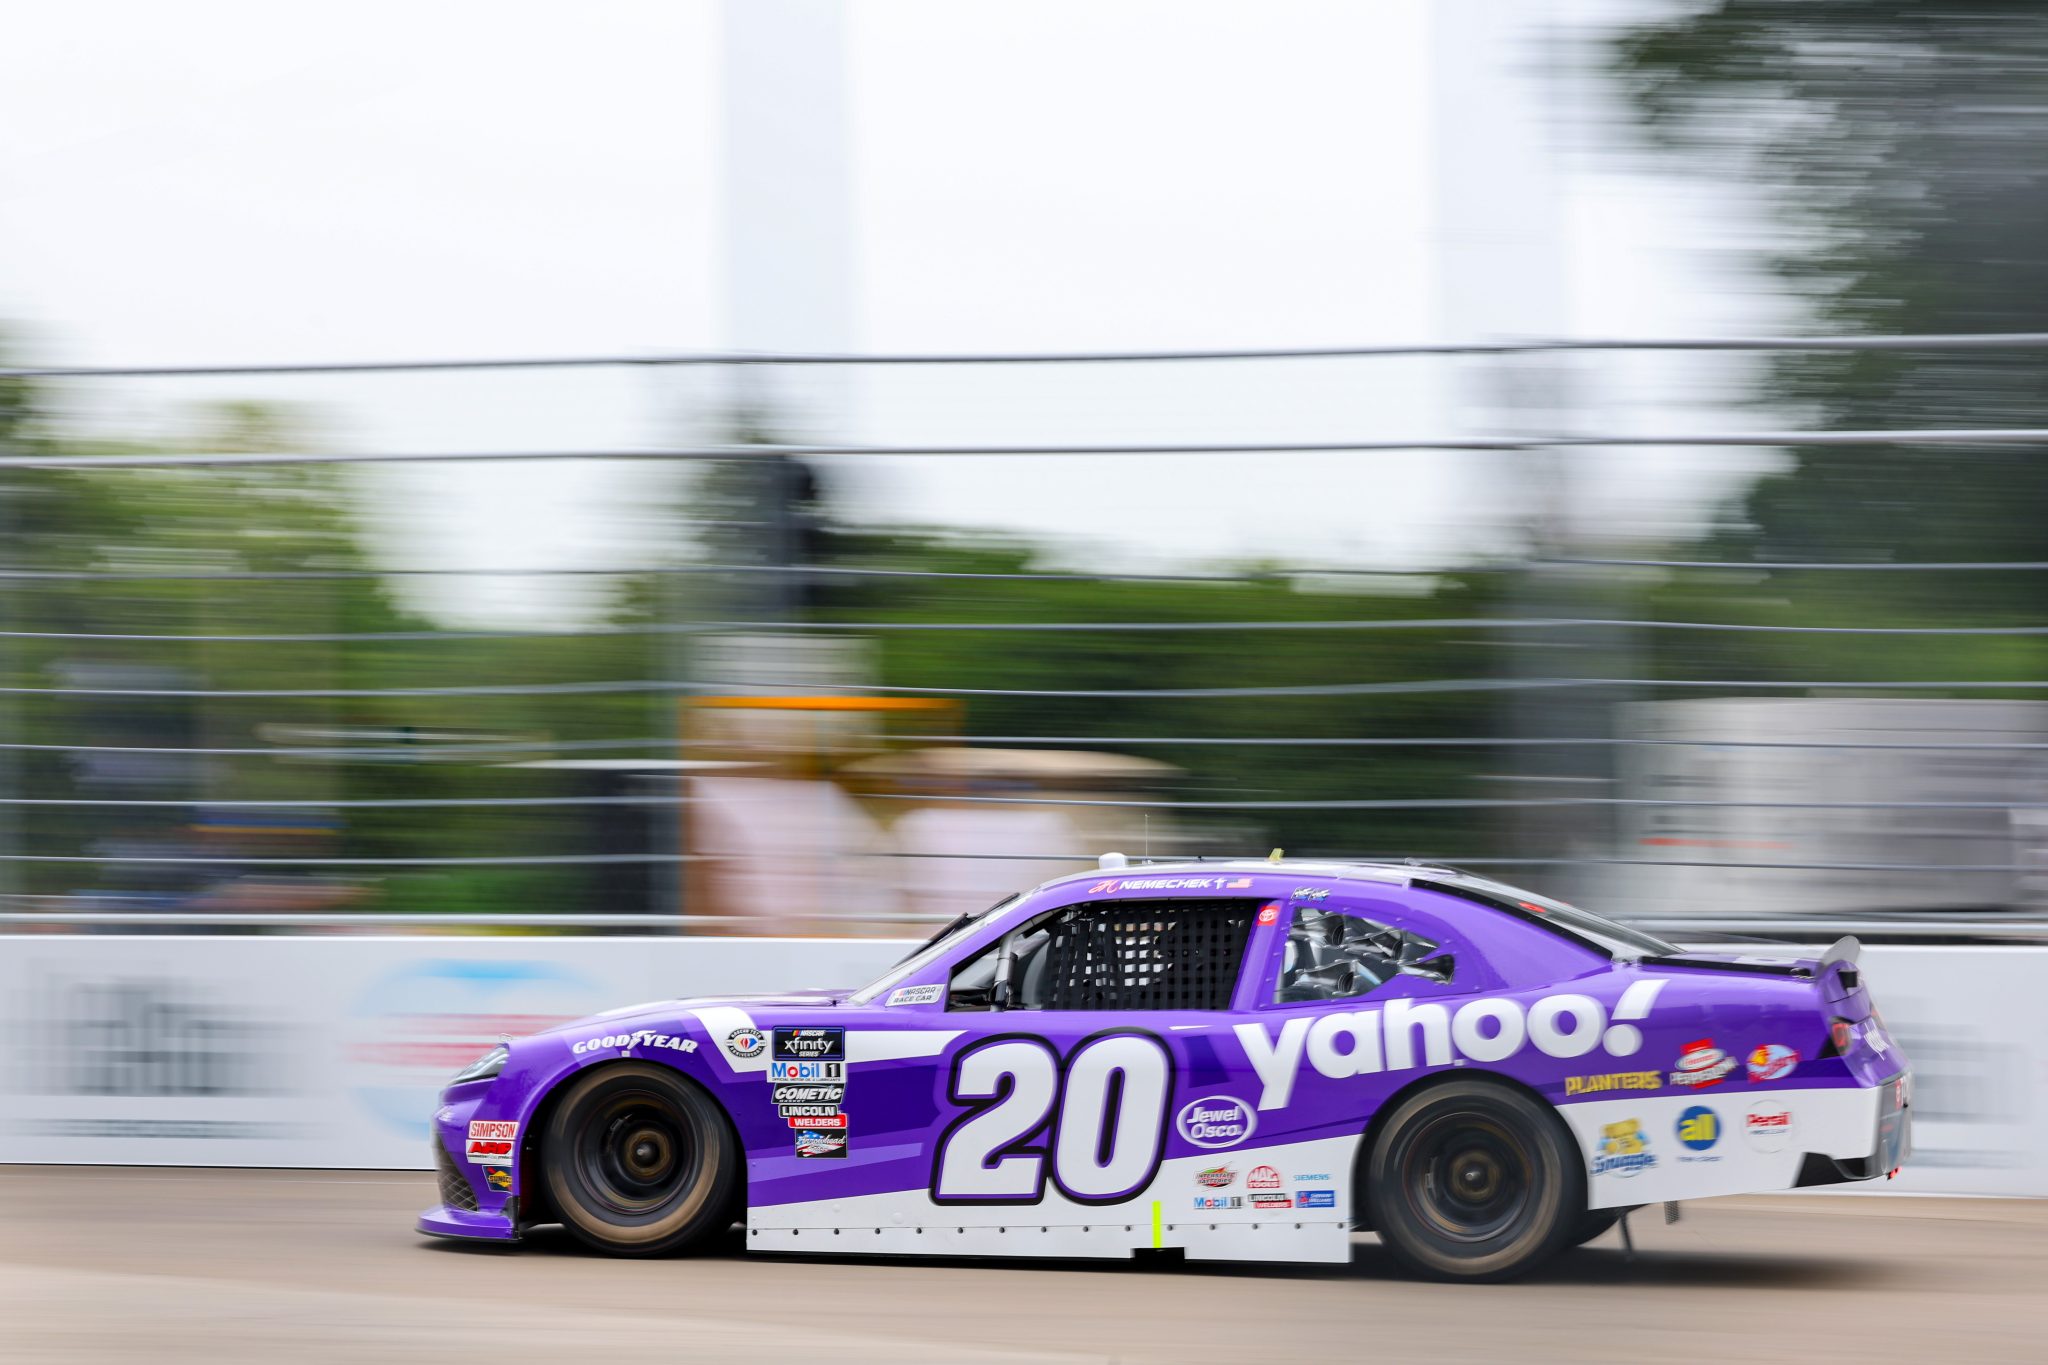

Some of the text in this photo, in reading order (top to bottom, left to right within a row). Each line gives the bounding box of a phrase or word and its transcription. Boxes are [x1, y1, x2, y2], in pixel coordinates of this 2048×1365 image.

[1119, 879, 1213, 890] NEMECHEK
[905, 987, 936, 995] NASCAR
[784, 1037, 835, 1054] xfinity
[1232, 978, 1669, 1111] yahoo!
[771, 1063, 838, 1077] Mobil 1
[1564, 1070, 1664, 1096] PLANTERS
[775, 1087, 842, 1100] COMETIC
[782, 1106, 835, 1116] LINCOLN
[937, 1034, 1168, 1201] 20
[1186, 1105, 1243, 1124] Jewel
[794, 1118, 841, 1127] WELDERS
[1746, 1111, 1792, 1127] Persil
[470, 1122, 516, 1138] SIMPSON
[1679, 1113, 1717, 1141] all
[467, 1142, 512, 1155] ARP
[1294, 1173, 1331, 1181] SIEMENS
[1194, 1196, 1228, 1207] Mobil
